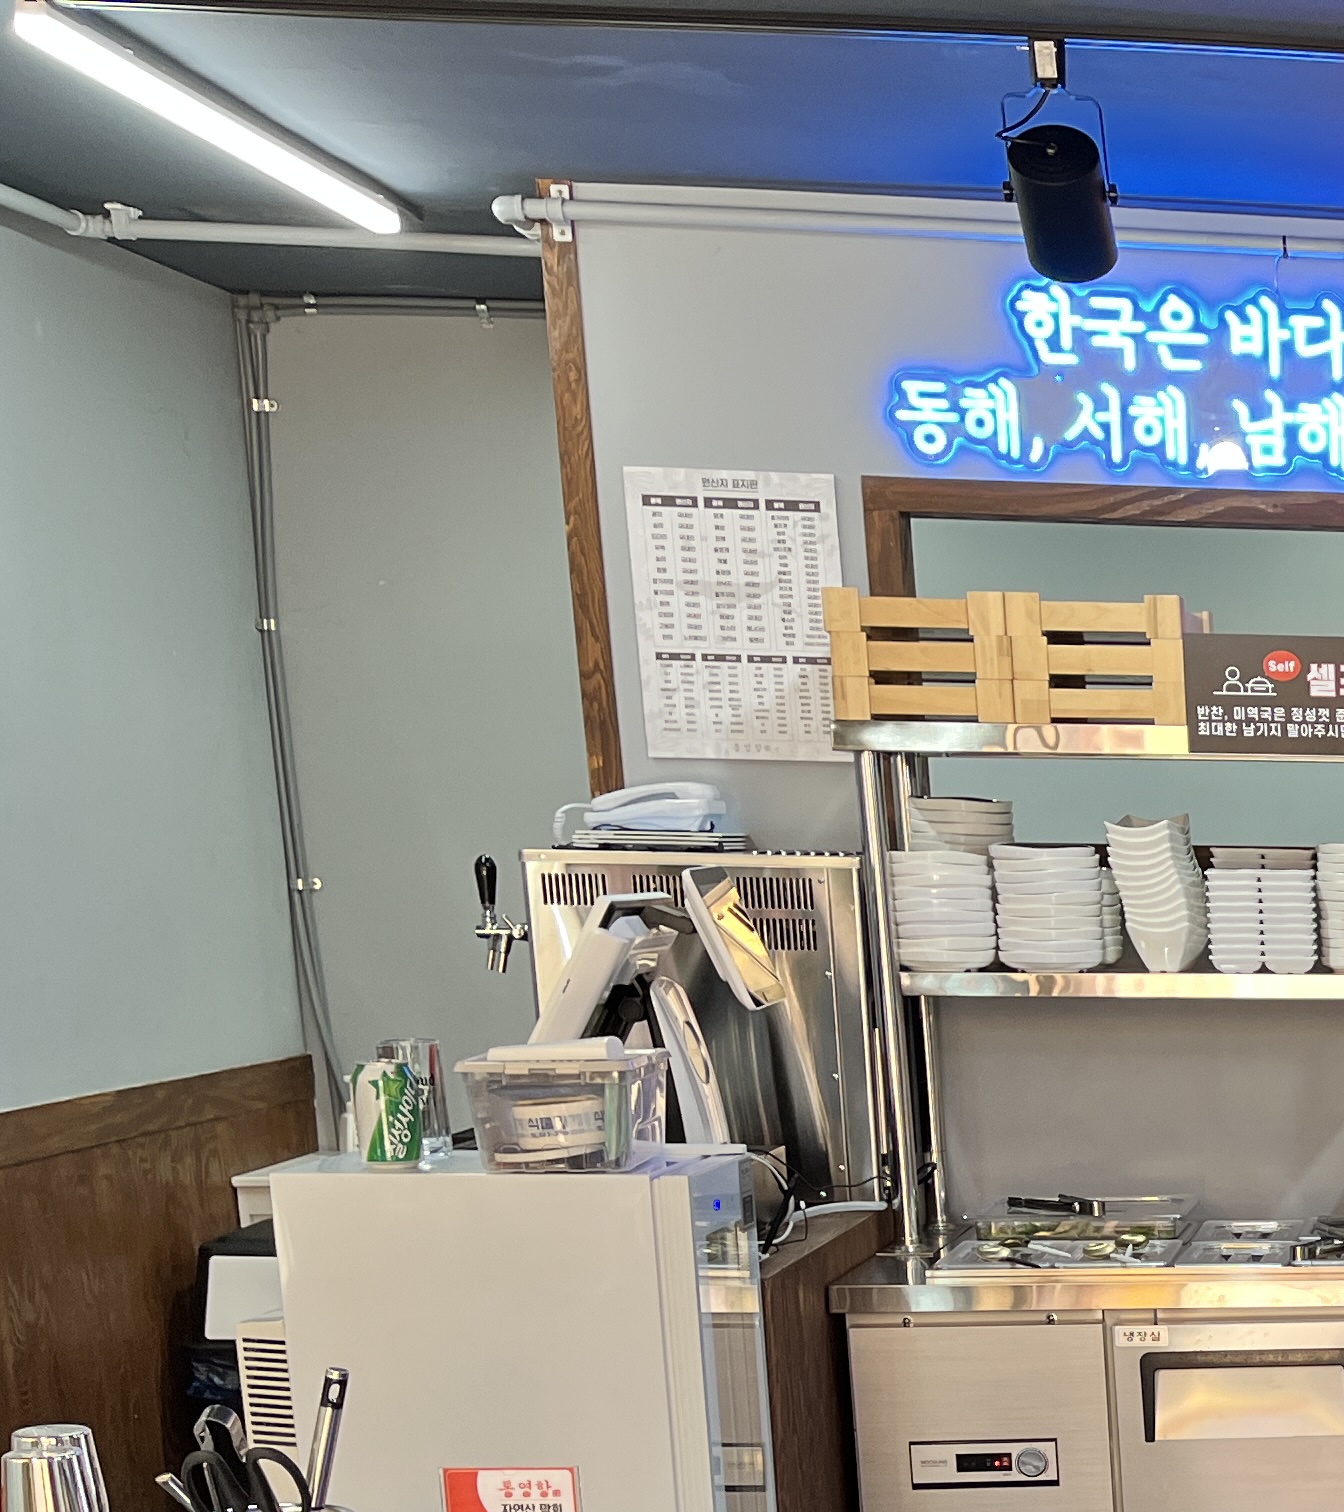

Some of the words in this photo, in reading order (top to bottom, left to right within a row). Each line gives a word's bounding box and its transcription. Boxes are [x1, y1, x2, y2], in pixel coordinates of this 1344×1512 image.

[1016, 285, 1209, 374] 한국은
[894, 378, 1044, 464] 동해,
[1267, 659, 1296, 673] Self
[1197, 705, 1228, 722] 반찬,
[1233, 706, 1286, 722] 미역국은
[1291, 707, 1330, 722] 정성껏
[1198, 722, 1237, 736] 최대한
[1242, 722, 1282, 737] 남기지
[1123, 1331, 1160, 1342] 냉장실
